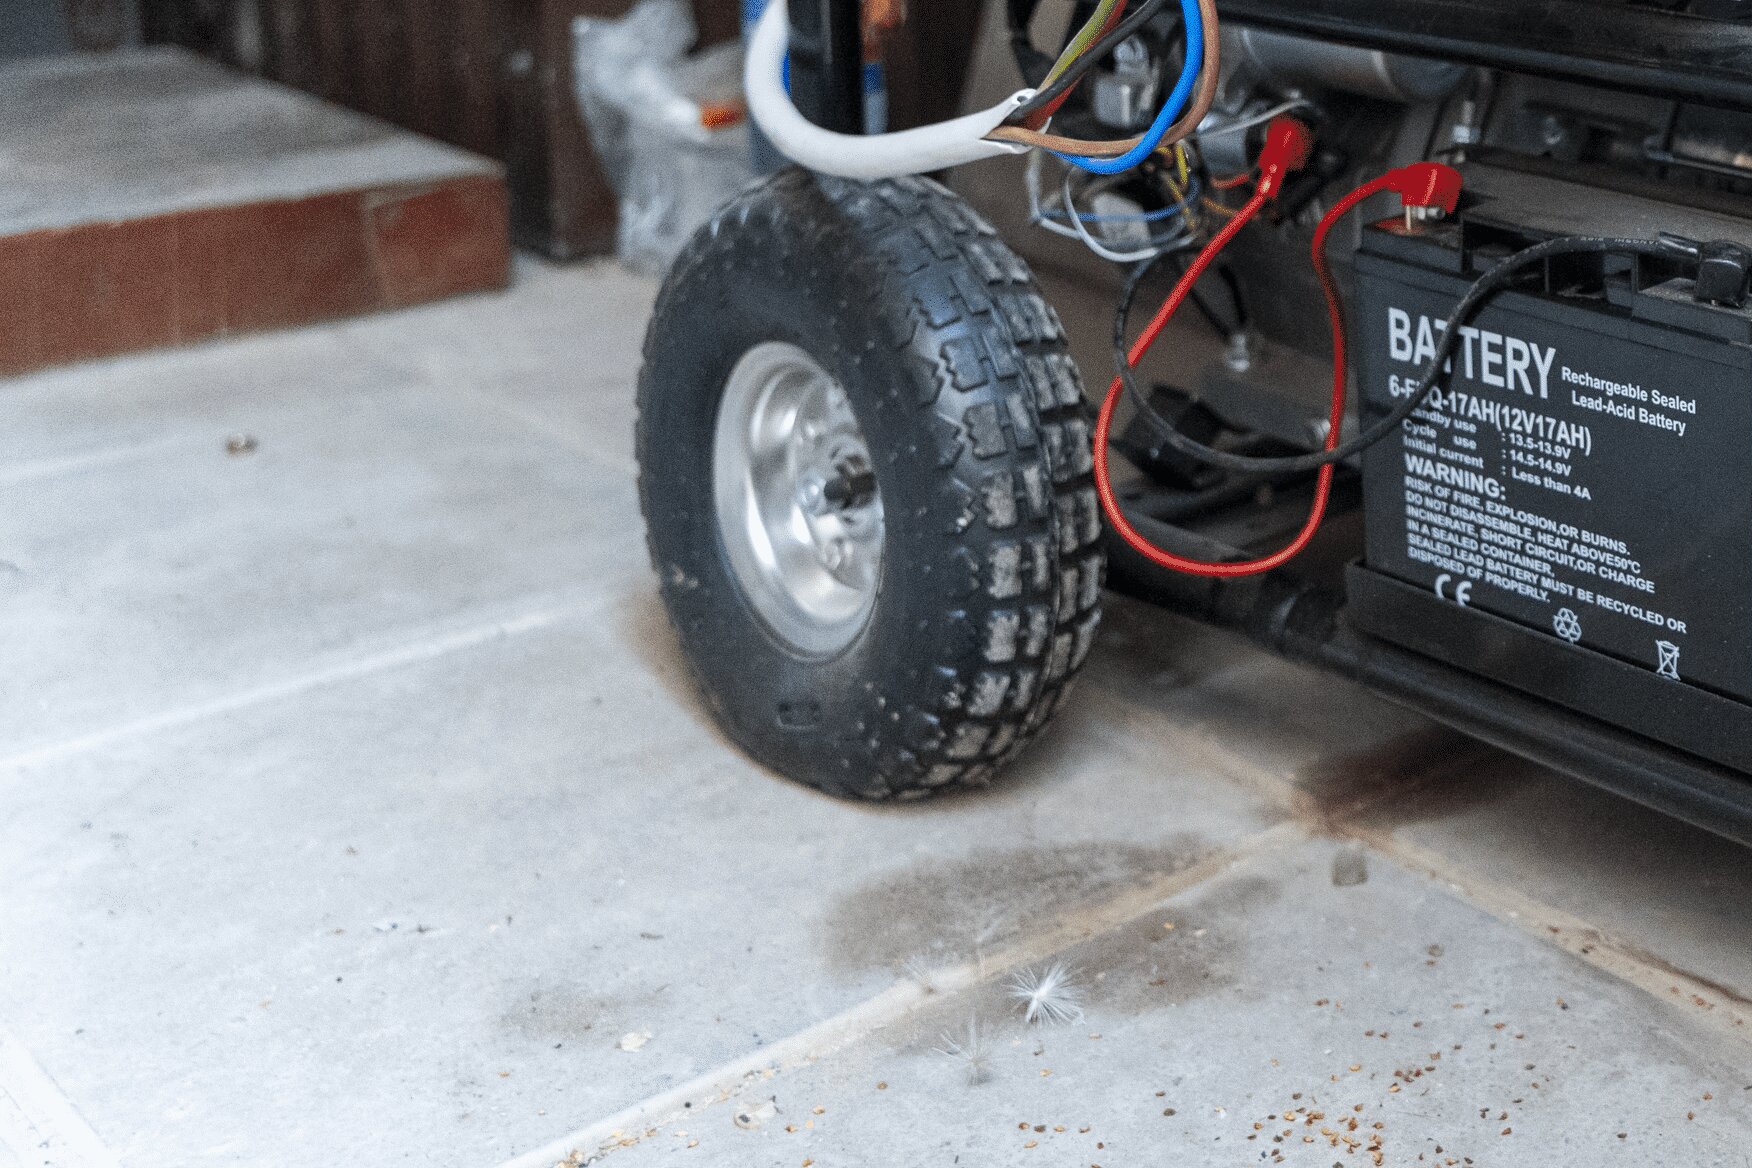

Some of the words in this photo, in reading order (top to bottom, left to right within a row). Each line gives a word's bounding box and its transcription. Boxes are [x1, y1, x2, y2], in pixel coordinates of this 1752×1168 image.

[1388, 374, 1592, 456] 6-FQ-17AH(12V17AH)
[1562, 366, 1648, 402] Rechargeable
[1652, 389, 1696, 414] Sealed
[1572, 390, 1636, 420] Lead-Acid
[1639, 407, 1686, 437] Battery
[1402, 418, 1437, 438] Cycle
[1453, 435, 1477, 450] use
[1510, 449, 1572, 477] 14.5-14.9V
[1403, 435, 1436, 454] Initial
[1439, 448, 1484, 469] current
[1512, 466, 1541, 486] Less
[1544, 476, 1571, 497] than
[1573, 485, 1592, 500] 4A
[1454, 419, 1477, 433] use
[1510, 432, 1571, 460] 13.5-13.9V
[1405, 454, 1506, 500] WARNING:
[1405, 475, 1433, 496] RISK
[1435, 484, 1451, 500] OF
[1581, 530, 1630, 555] BURNS.
[1406, 490, 1421, 506] DO
[1423, 494, 1448, 514] NOT
[1538, 530, 1570, 551] HEAT
[1407, 518, 1420, 533] IN
[1420, 522, 1430, 536] A
[1432, 526, 1478, 552] SEALED
[1408, 546, 1464, 574] DISPOSED
[1466, 564, 1484, 580] OF
[1485, 571, 1550, 604] PROPERLY.
[1408, 533, 1452, 559] SEALED
[1454, 544, 1485, 569] LEAD
[1486, 556, 1539, 587] BATTERY
[1541, 577, 1575, 596] MUST
[1577, 588, 1595, 604] BE
[1596, 595, 1664, 626] RECYCLED
[1666, 618, 1687, 632] OR
[1480, 525, 1521, 550] SHORT
[1598, 565, 1655, 594] CHARGE
